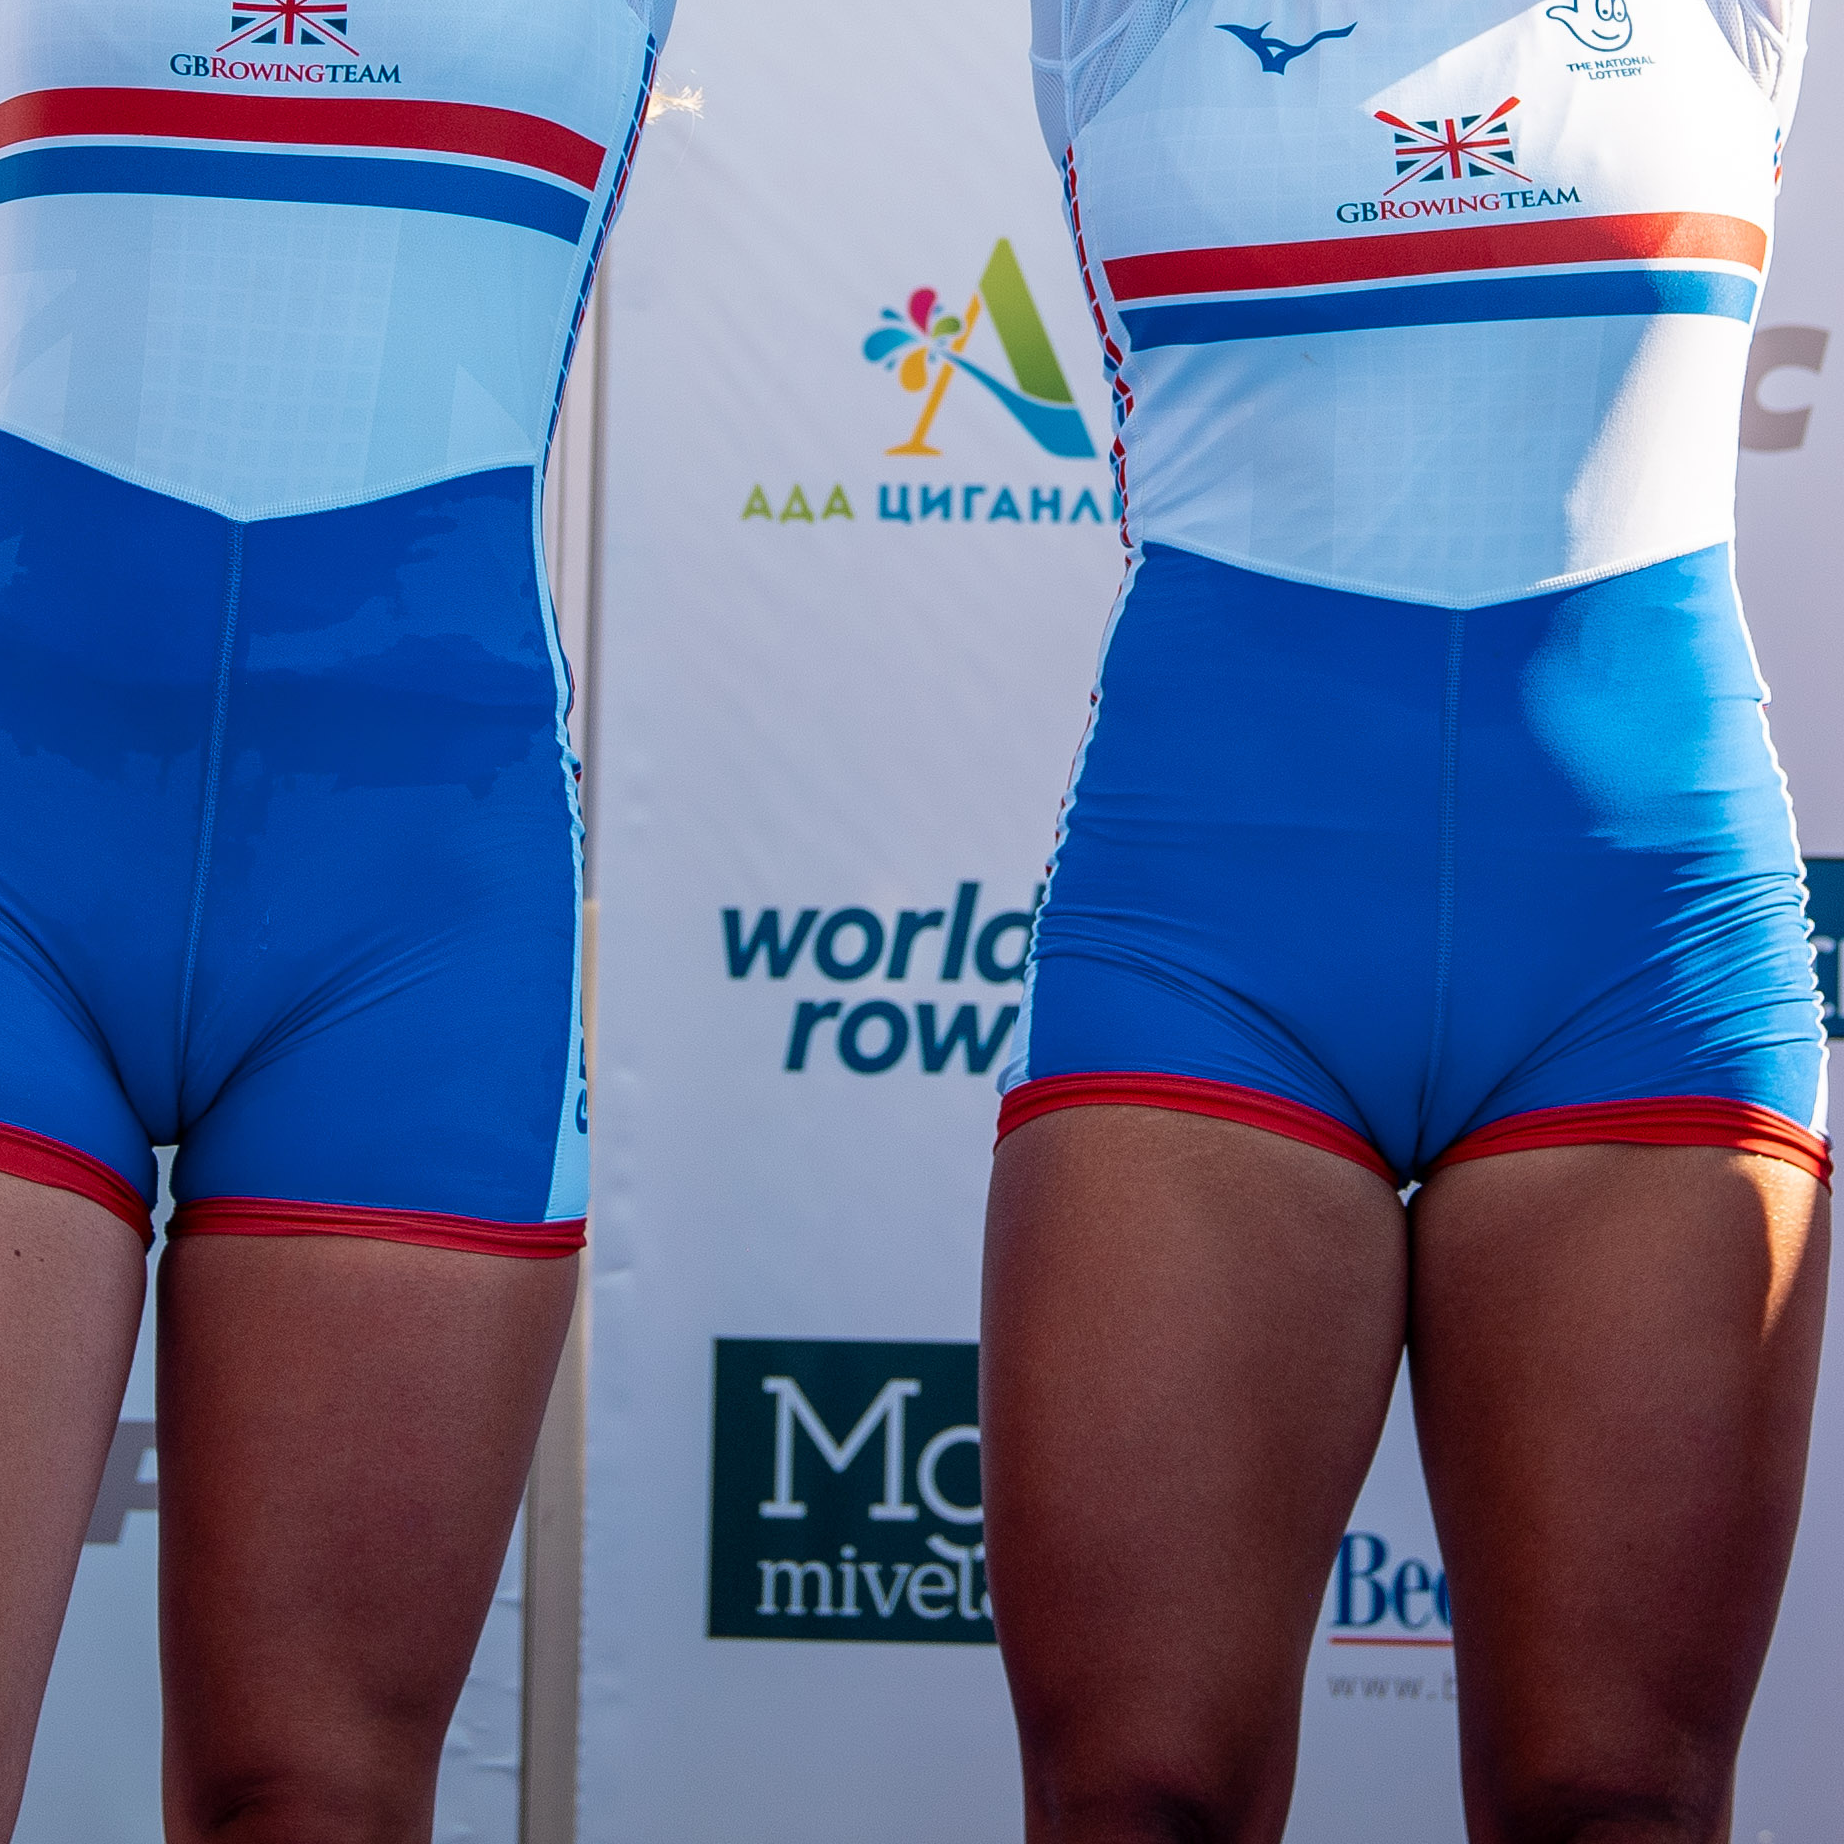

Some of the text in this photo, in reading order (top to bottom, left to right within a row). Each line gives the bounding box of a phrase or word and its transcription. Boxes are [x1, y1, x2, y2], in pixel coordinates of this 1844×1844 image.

[1566, 55, 1656, 72] THE NATIONAL
[1588, 67, 1642, 81] LOTTERY
[740, 482, 1123, 525] АДА ЦИГАНЛ
